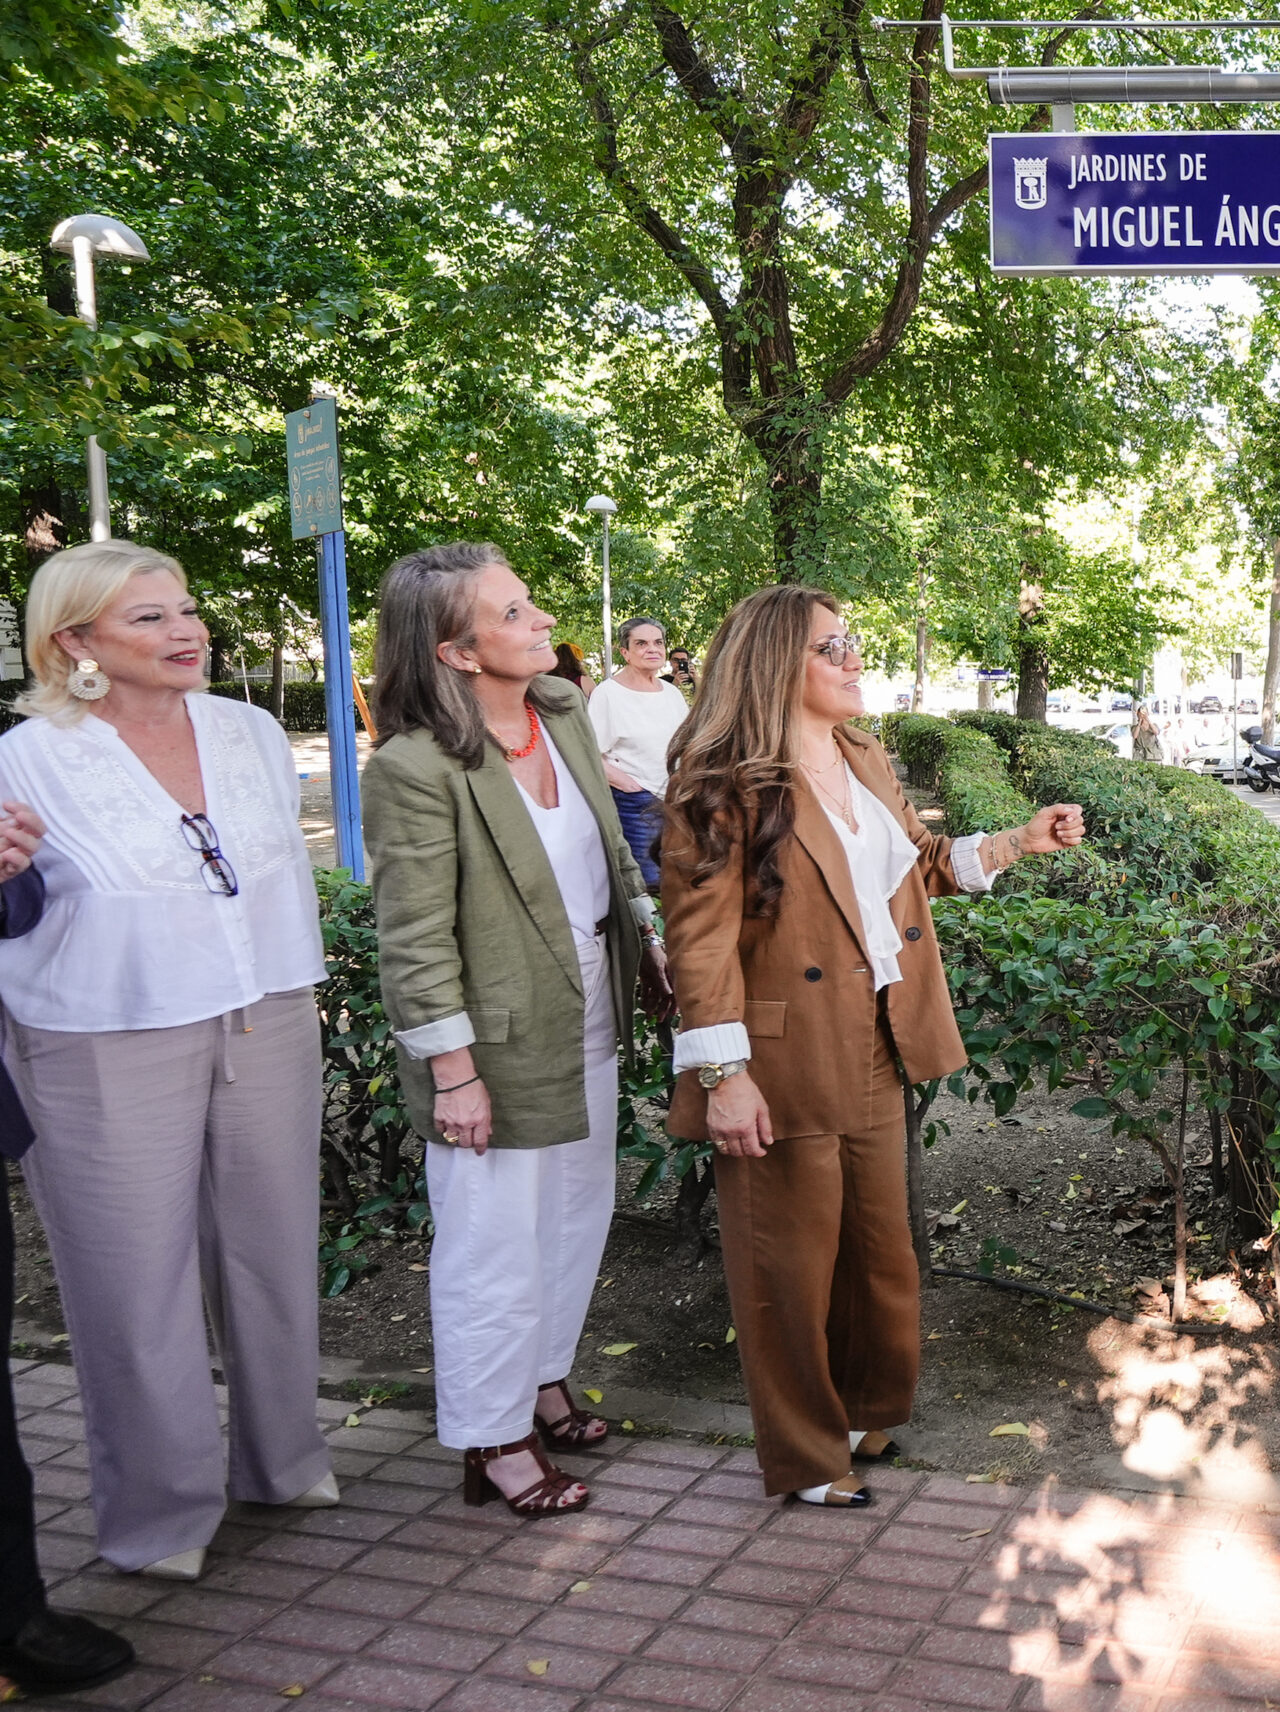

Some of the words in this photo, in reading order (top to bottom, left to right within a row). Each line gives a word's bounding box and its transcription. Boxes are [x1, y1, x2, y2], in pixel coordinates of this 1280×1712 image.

[1067, 152, 1168, 190] JARDINES
[1179, 152, 1208, 182] DE
[1073, 204, 1204, 249] MIGUEL
